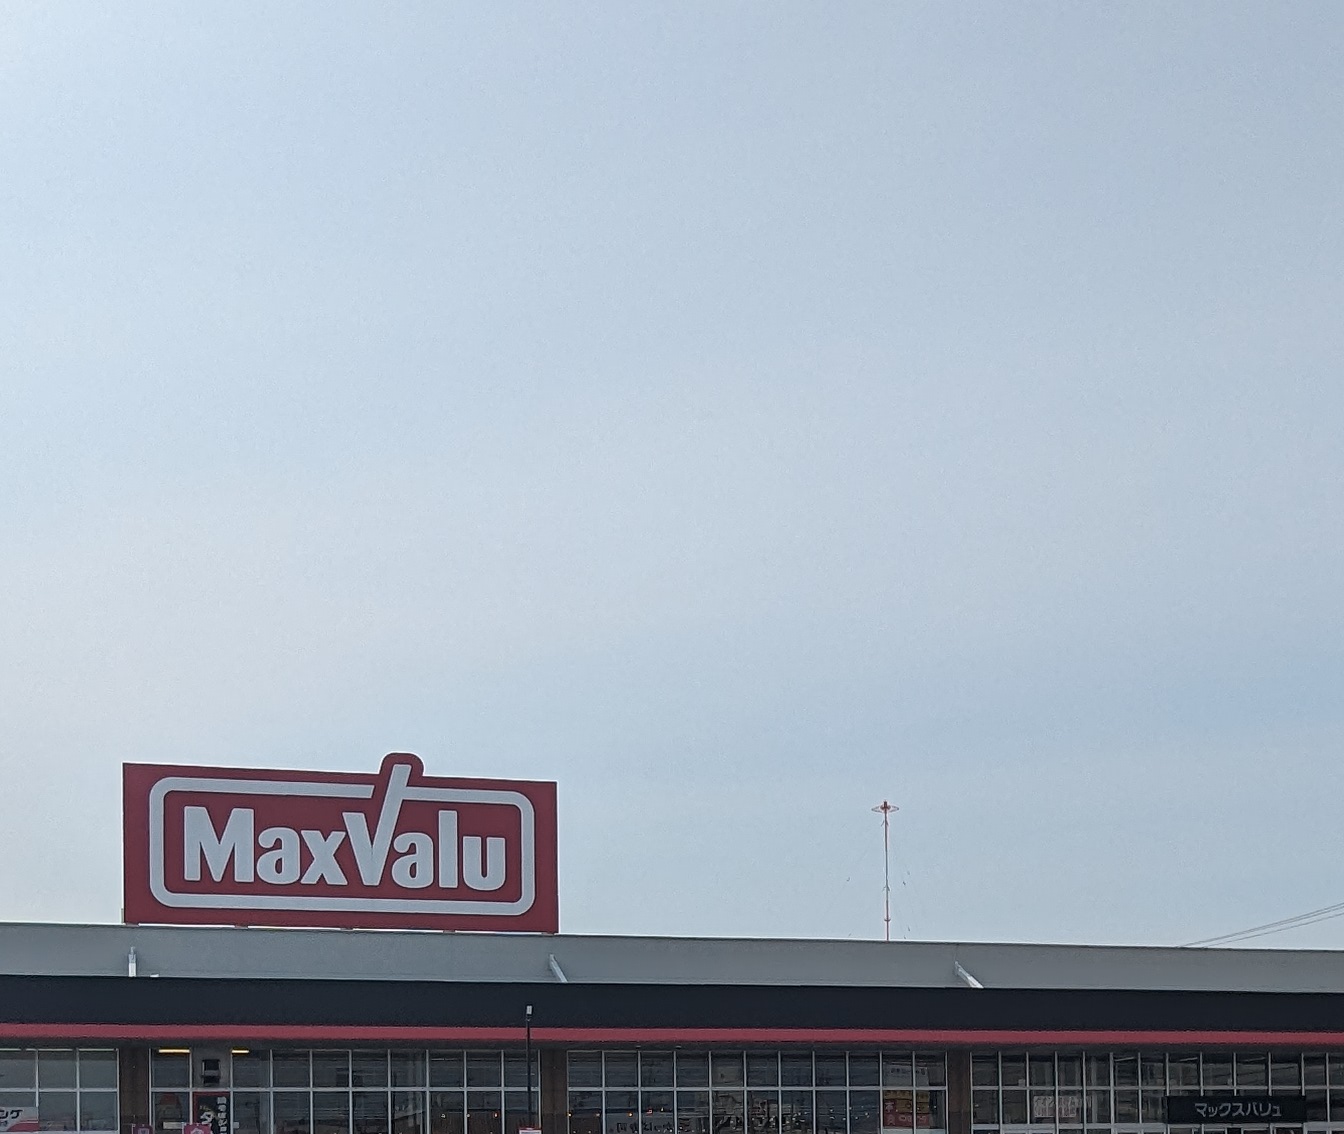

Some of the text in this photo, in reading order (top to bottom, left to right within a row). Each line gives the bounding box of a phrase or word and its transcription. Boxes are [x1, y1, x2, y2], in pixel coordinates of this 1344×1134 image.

[183, 763, 507, 891] MaxValu
[1194, 1102, 1282, 1118] マックスバリュ
